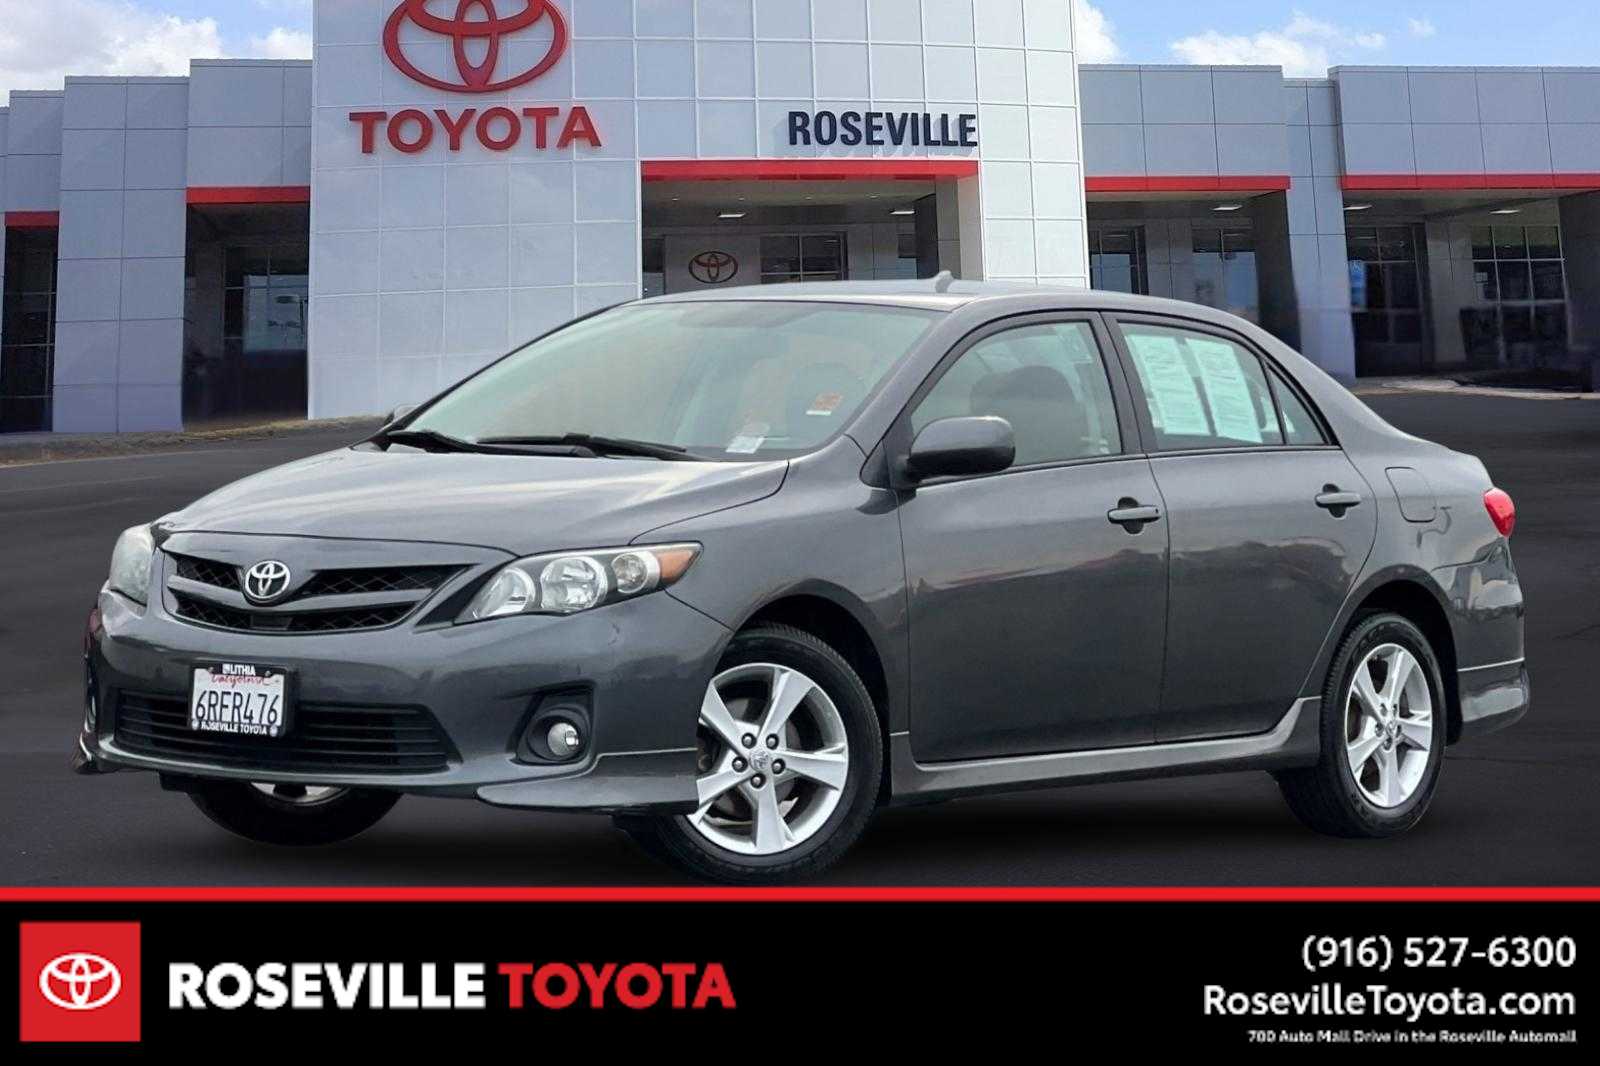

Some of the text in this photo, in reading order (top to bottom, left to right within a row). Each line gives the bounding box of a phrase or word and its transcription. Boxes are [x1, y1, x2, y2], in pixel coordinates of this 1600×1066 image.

[349, 106, 602, 154] TOYOTA
[788, 111, 978, 147] ROSEVILLE
[230, 664, 256, 676] LITHIA
[201, 720, 268, 735] ROSEVILLE TOYOTA
